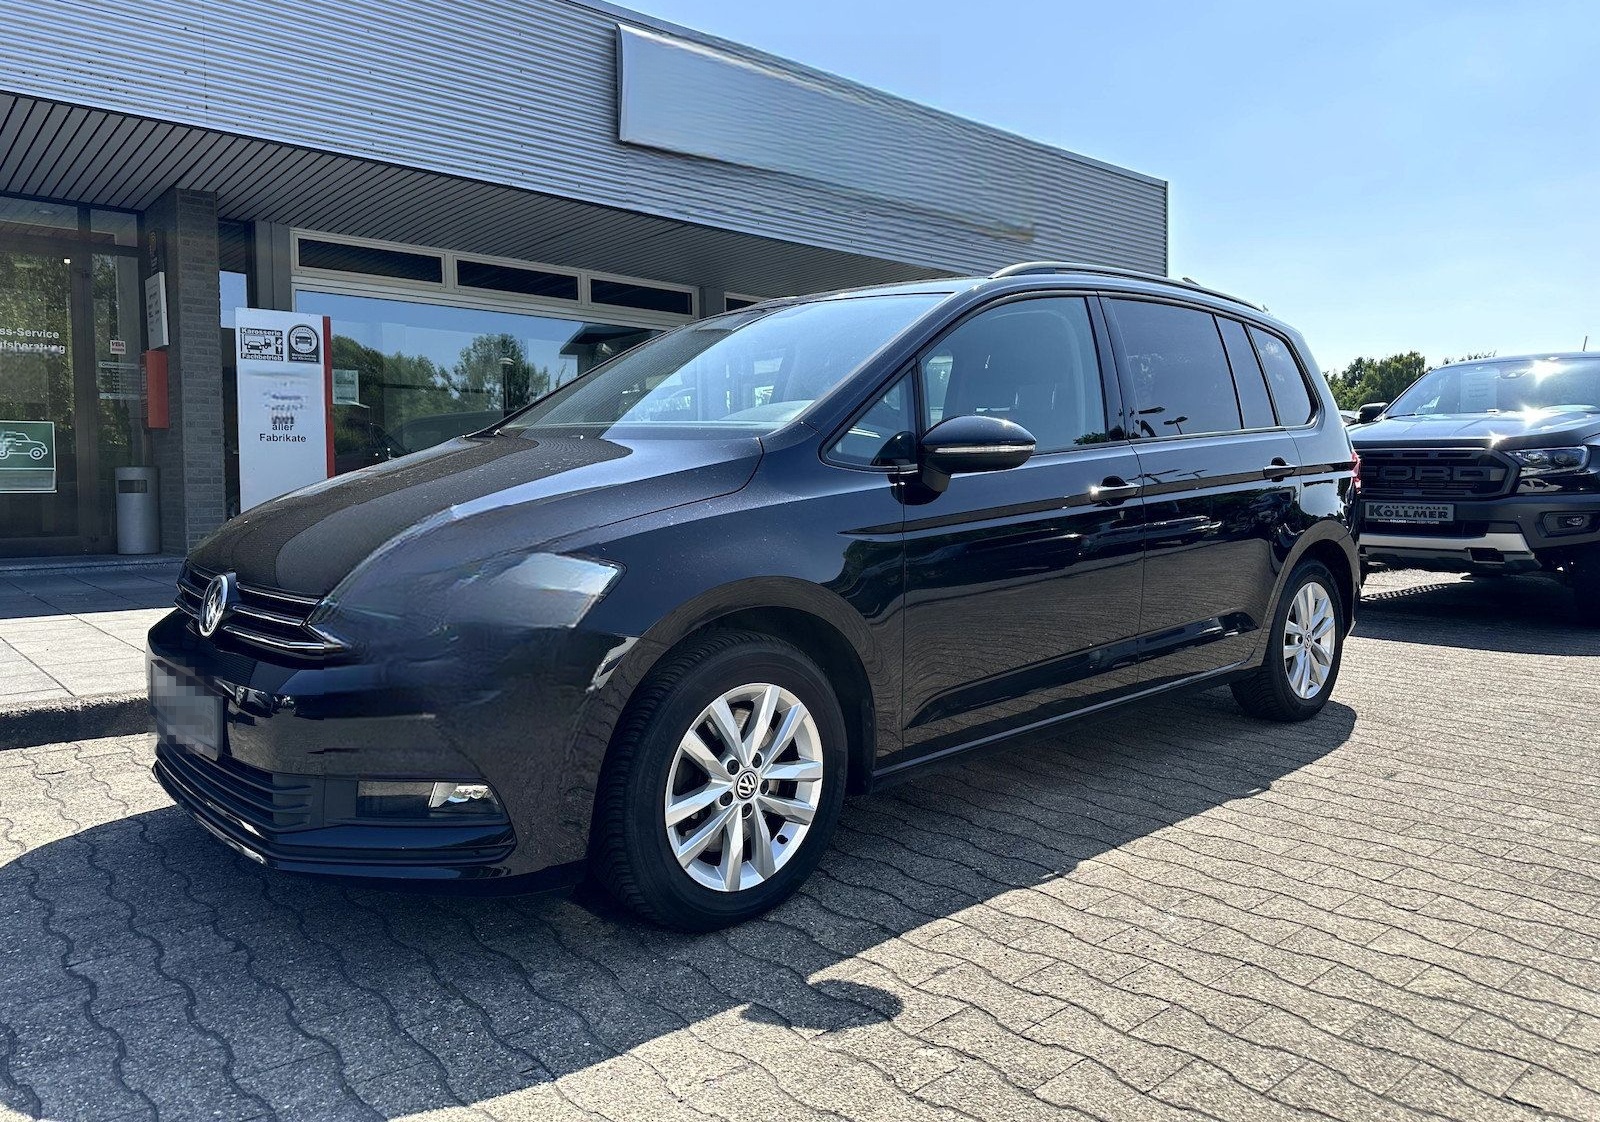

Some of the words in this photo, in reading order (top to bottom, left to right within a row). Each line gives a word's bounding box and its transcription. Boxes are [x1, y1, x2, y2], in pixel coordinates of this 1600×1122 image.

[241, 327, 282, 336] Karosserie
[242, 353, 283, 361] Fachbetrieb
[272, 423, 294, 431] aller
[259, 433, 307, 443] Fabrikate
[1368, 504, 1448, 519] KOLLMER
